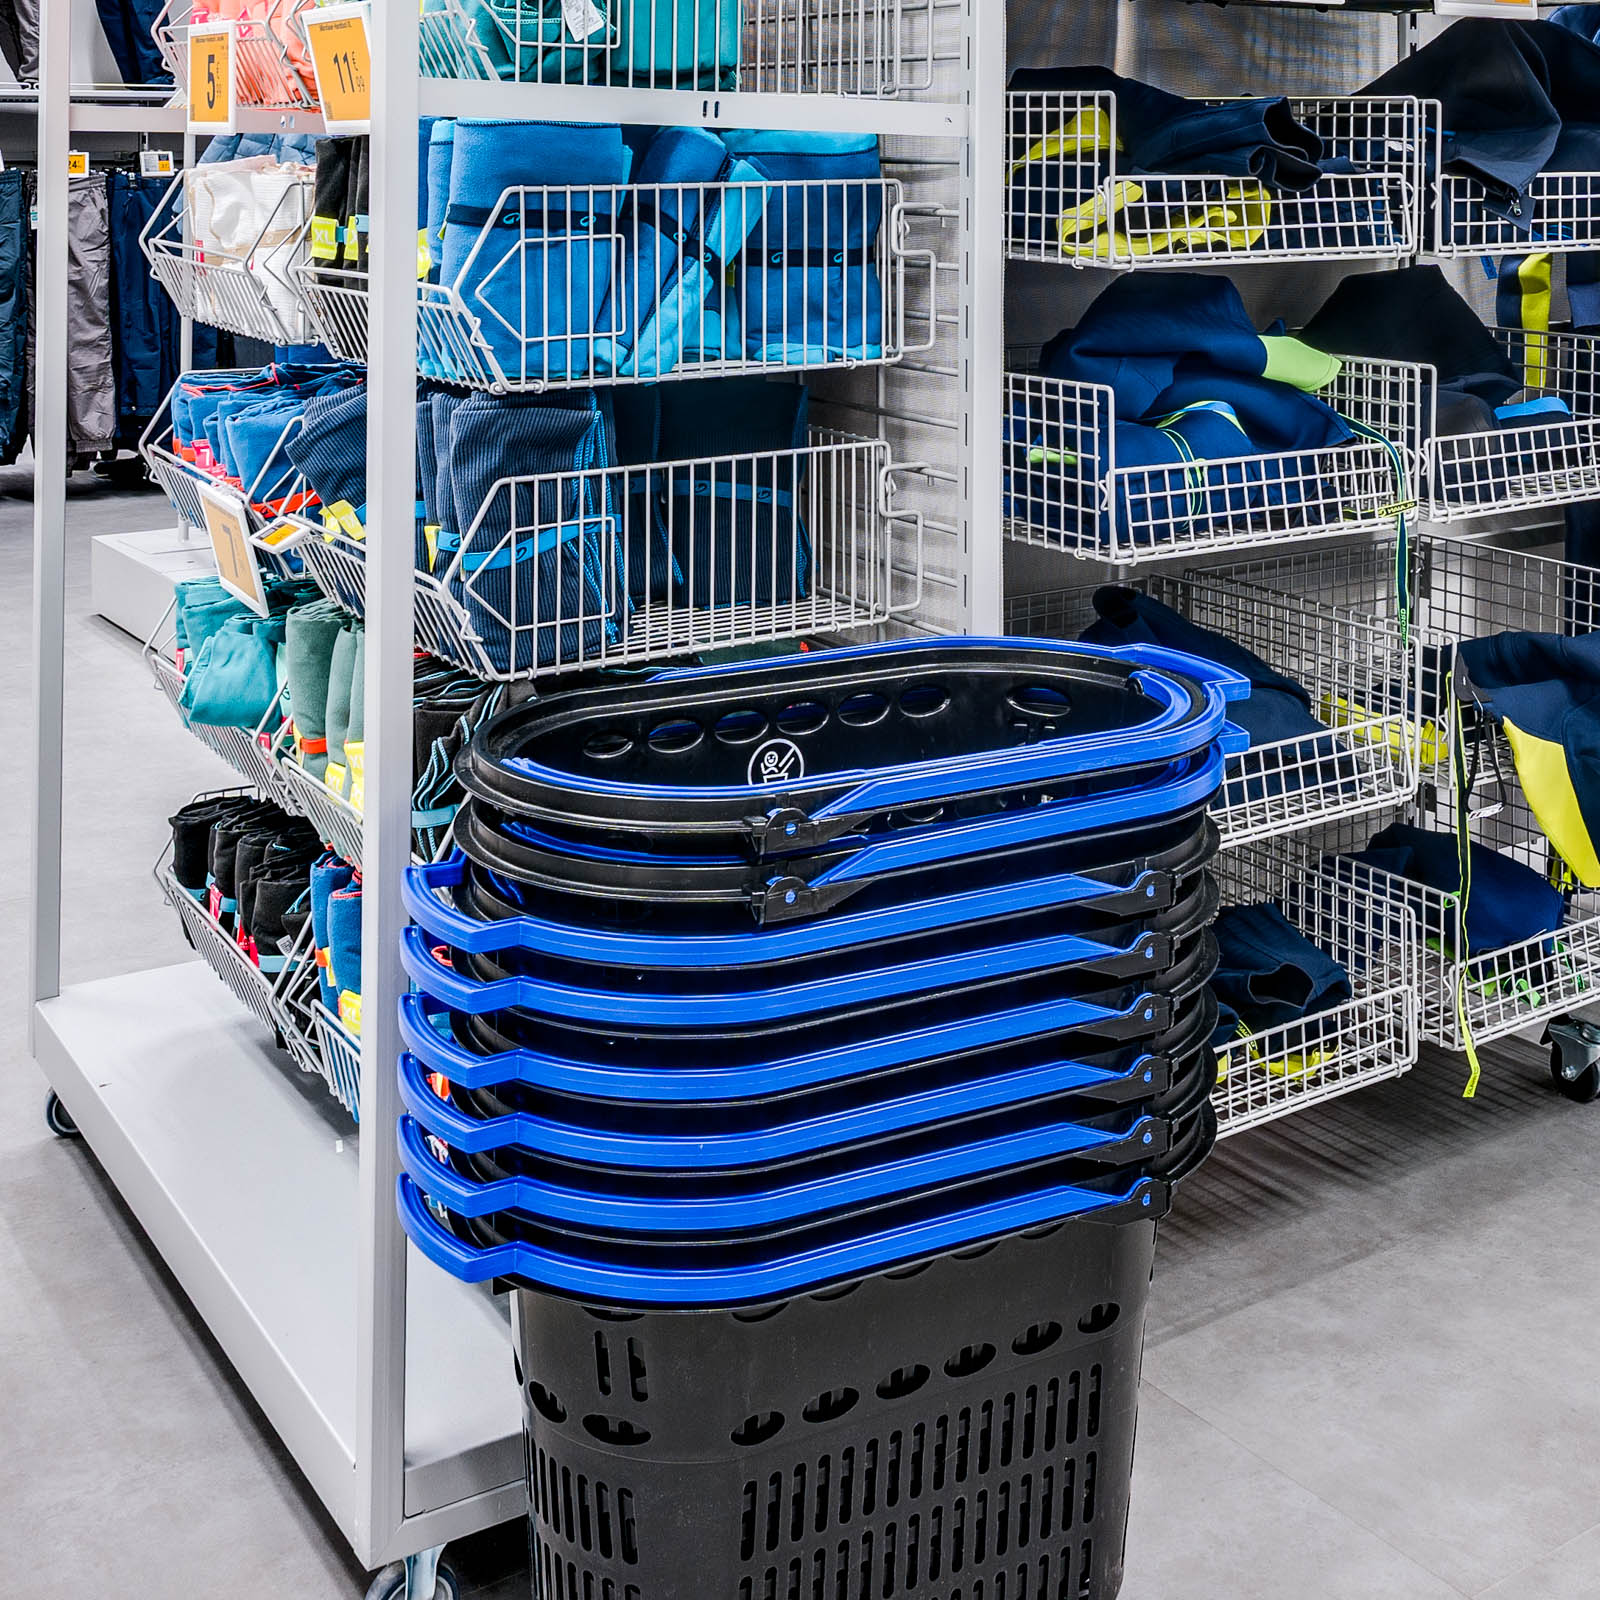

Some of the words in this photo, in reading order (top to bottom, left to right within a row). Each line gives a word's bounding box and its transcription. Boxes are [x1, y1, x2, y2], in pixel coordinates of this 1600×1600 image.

[207, 53, 216, 109] 5
[334, 50, 356, 94] 11
[314, 228, 336, 245] XL
